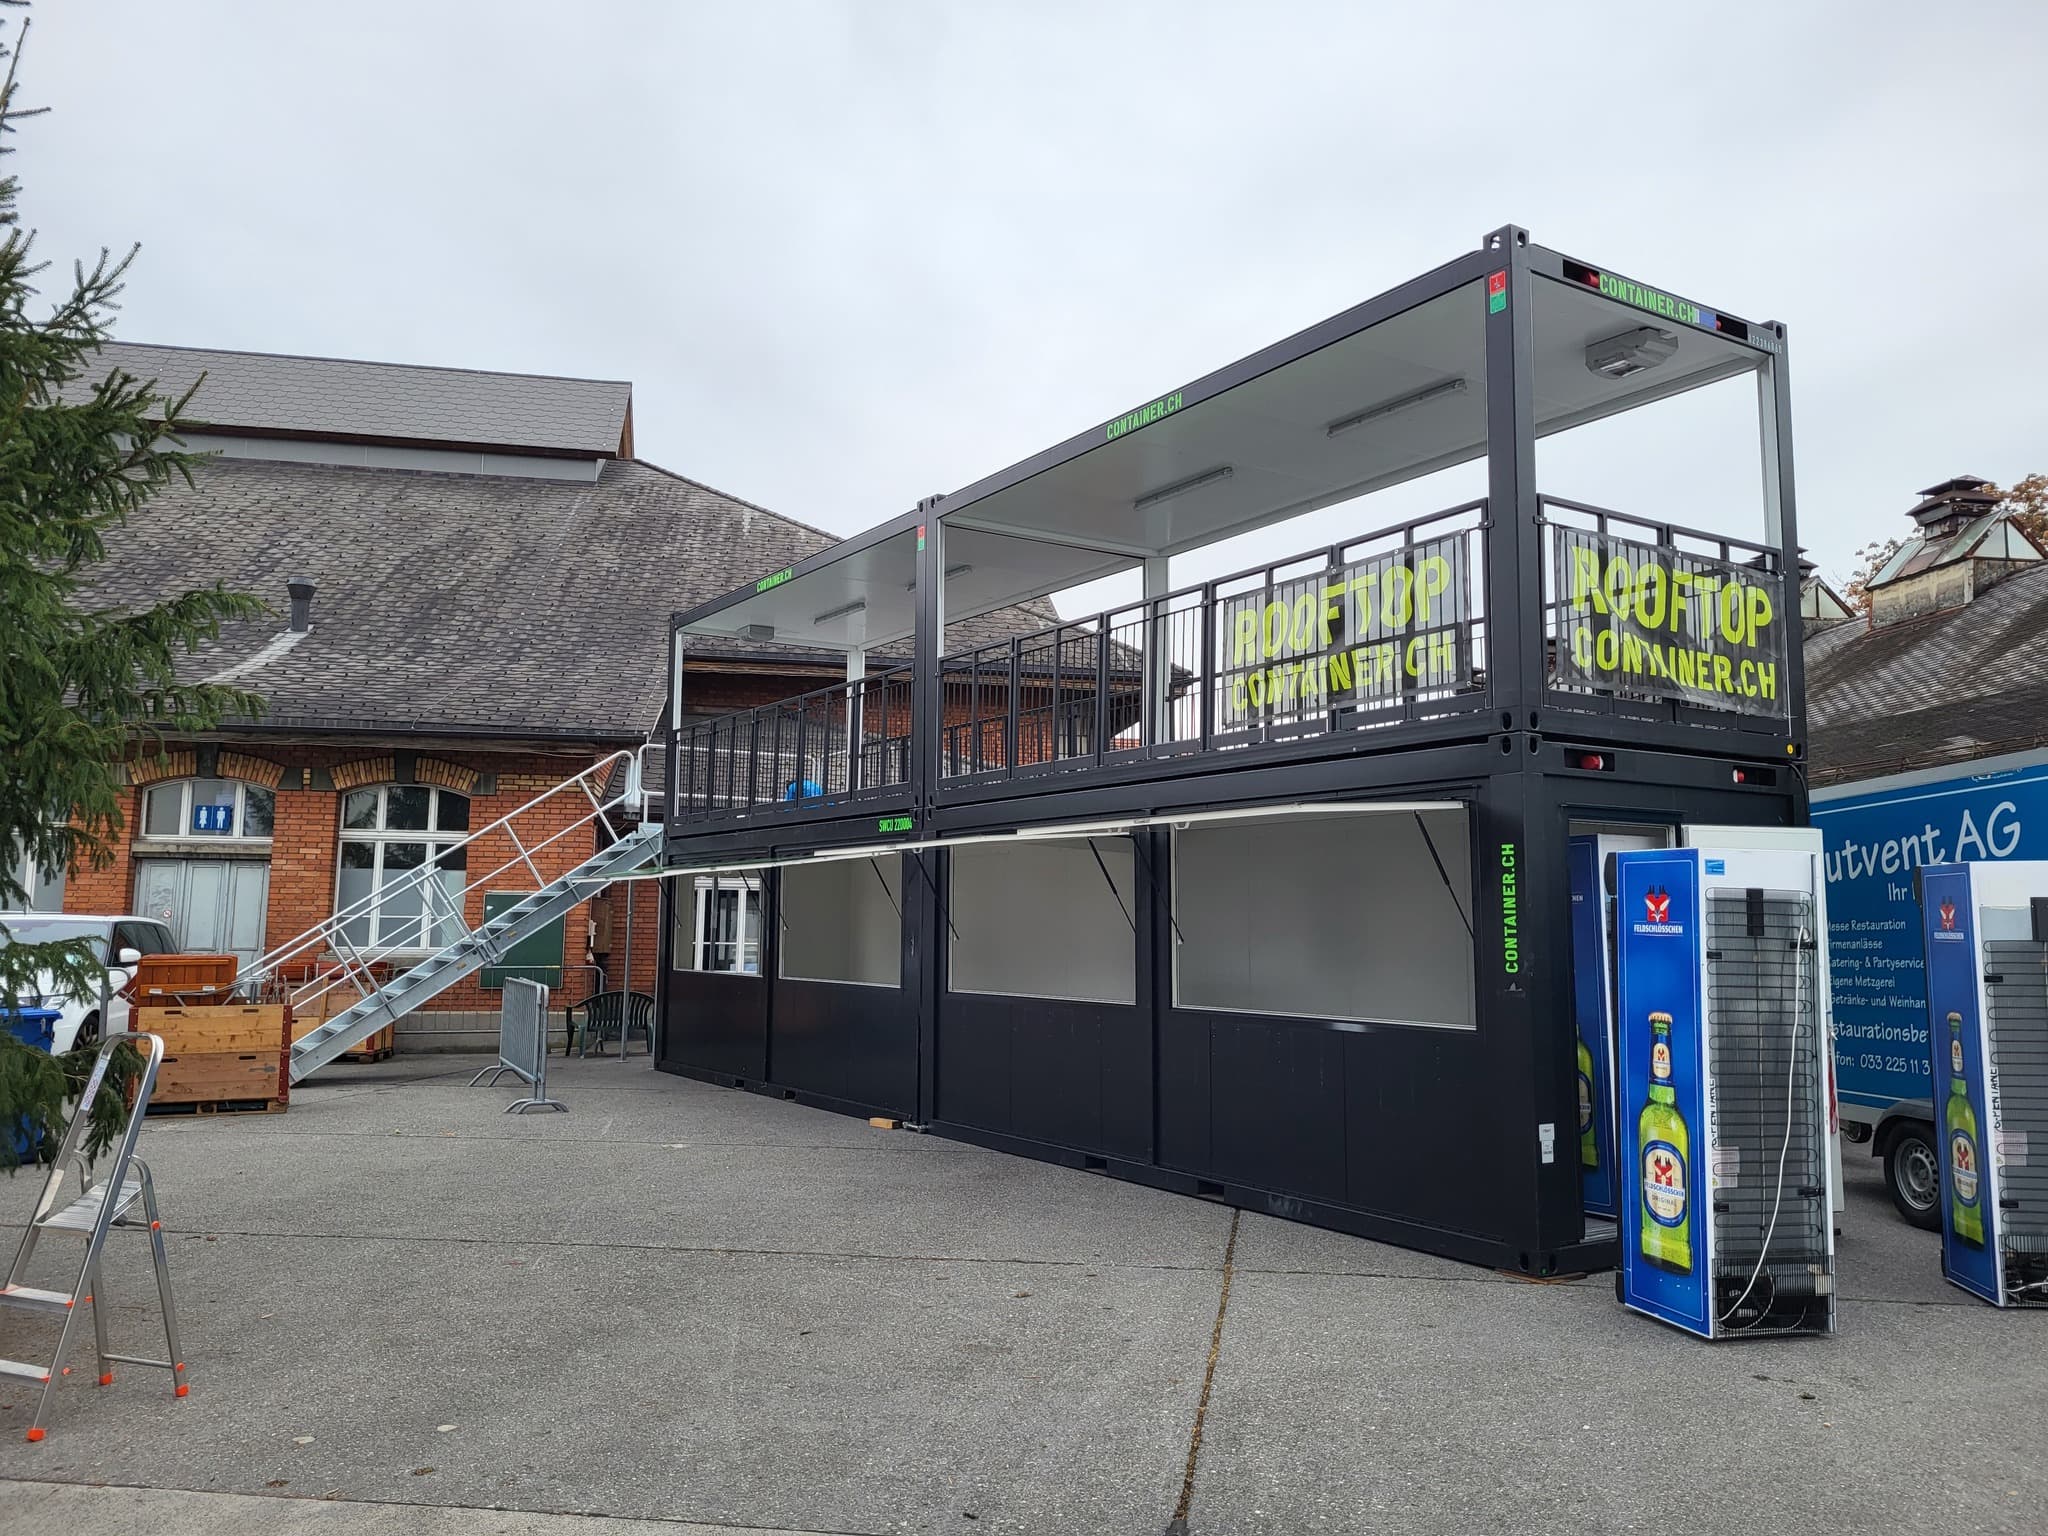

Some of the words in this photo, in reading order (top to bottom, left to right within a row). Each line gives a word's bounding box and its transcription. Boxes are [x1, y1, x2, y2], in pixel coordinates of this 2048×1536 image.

[1600, 273, 1697, 324] CONTAINER.CH
[1106, 392, 1183, 440] CONTAINER.CH
[1233, 555, 1450, 667] ROOFTOP
[1571, 545, 1773, 648] ROOFTOP
[1231, 630, 1453, 712] CONTAINER.CH
[1574, 626, 1775, 700] CONTAINER.CH
[1954, 801, 2021, 863] AG
[1501, 842, 1519, 974] CONTAINER.CH
[1851, 918, 1906, 931] Restauration
[1855, 976, 1896, 990] Metzgerei
[1864, 956, 1872, 968] &
[1870, 995, 1887, 1007] und
[1860, 1054, 1883, 1070] 033
[1885, 1056, 1907, 1072] 225
[1910, 1059, 1919, 1074] 11
